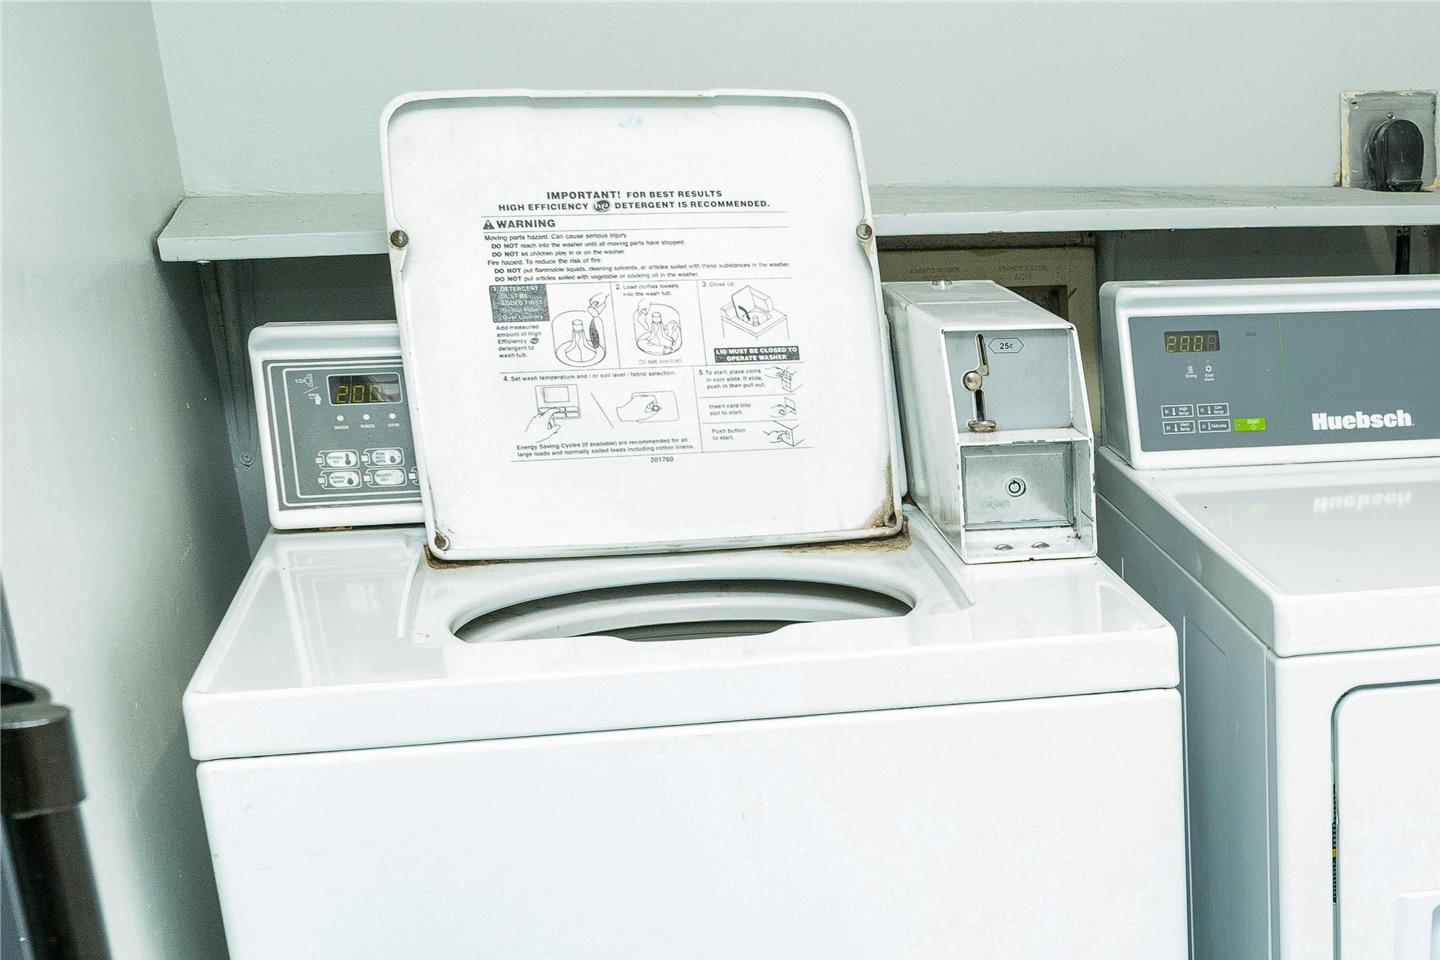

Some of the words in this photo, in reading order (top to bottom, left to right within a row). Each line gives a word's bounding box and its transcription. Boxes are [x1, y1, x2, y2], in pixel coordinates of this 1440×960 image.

[547, 191, 620, 200] IMPORTANT!
[678, 190, 722, 198] RESULTS
[528, 203, 588, 211] EFFICIENCY
[615, 201, 675, 209] DETERGENT
[691, 200, 770, 208] RECOMMENDED.
[496, 219, 556, 229] WARNING
[1312, 409, 1412, 431] Huebsch
